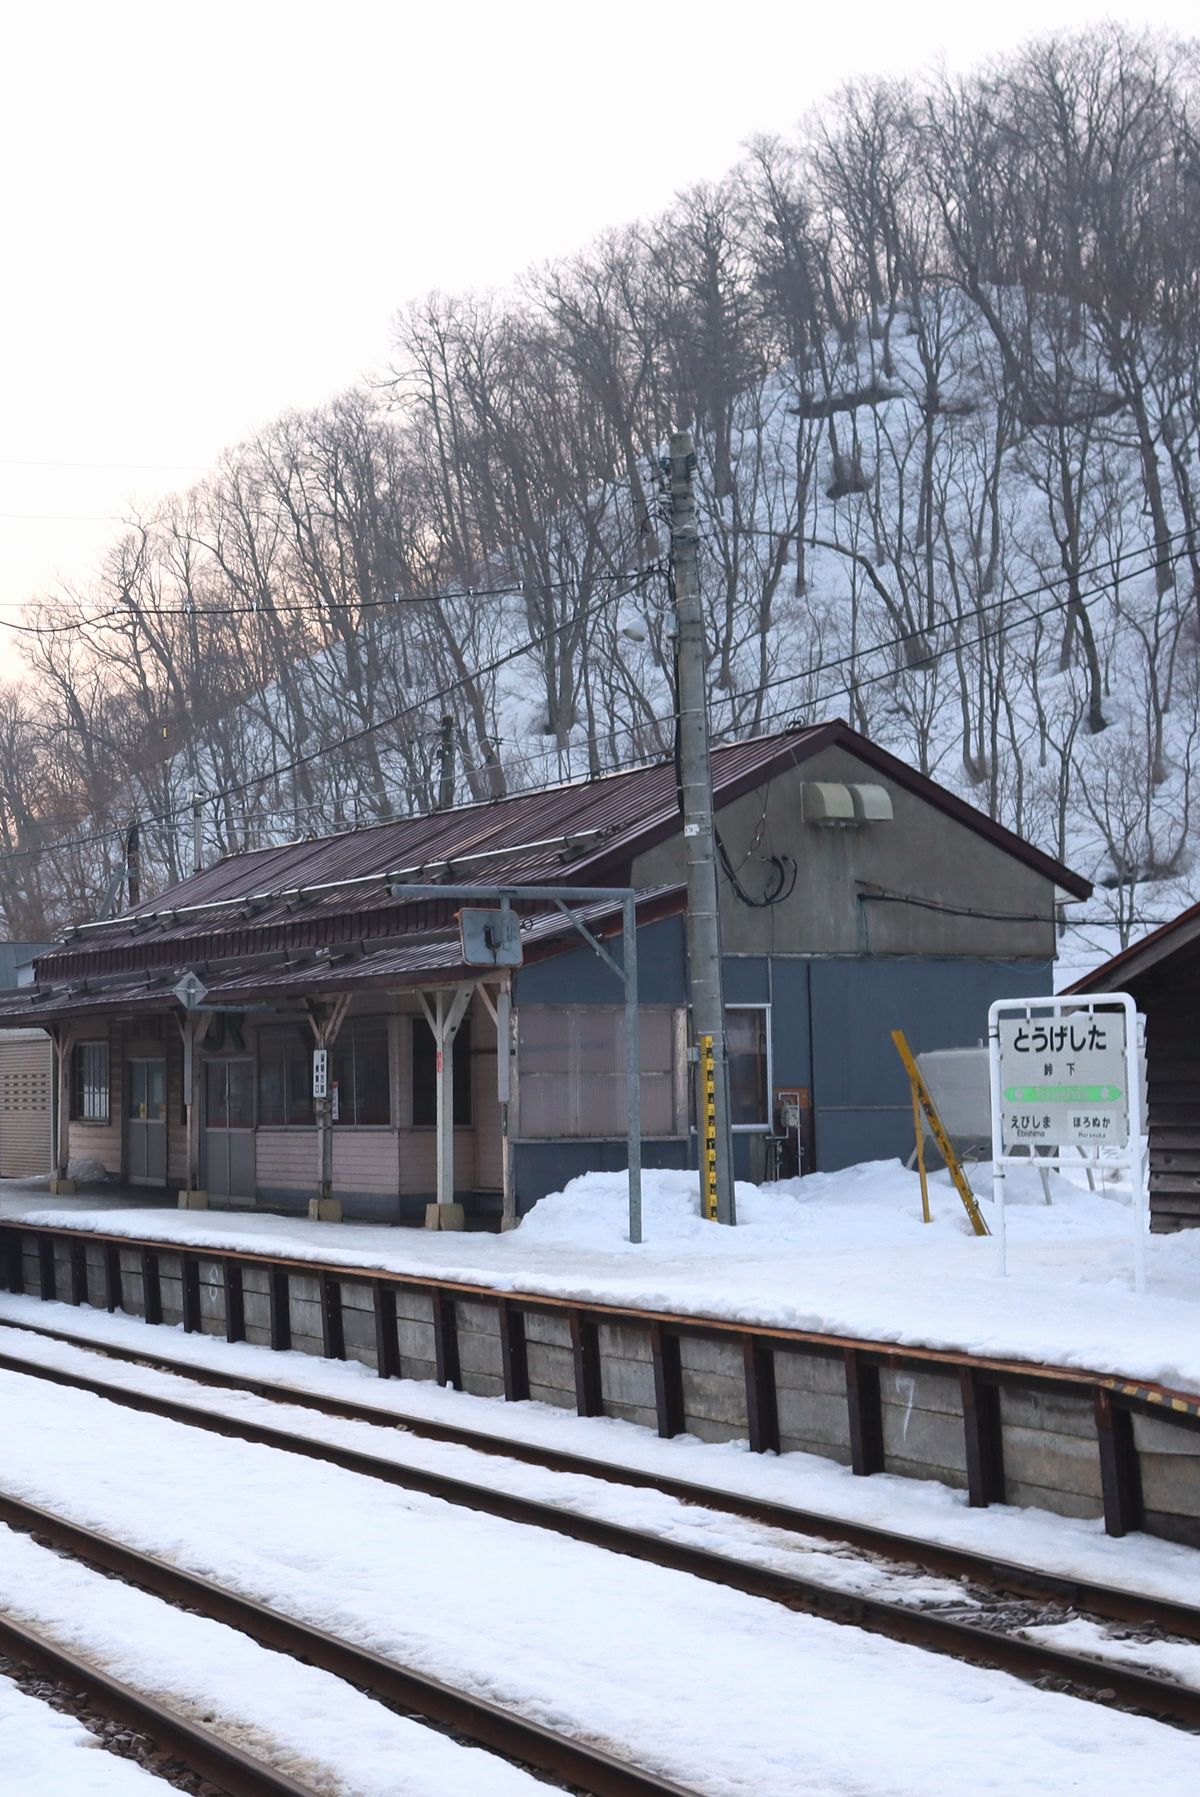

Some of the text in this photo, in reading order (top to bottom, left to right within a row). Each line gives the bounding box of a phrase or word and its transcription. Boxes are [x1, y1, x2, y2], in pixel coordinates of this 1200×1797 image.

[1013, 1024, 1107, 1053] とうげした
[1043, 1062, 1076, 1077] 峠下
[1010, 1115, 1051, 1129] えびしま
[1073, 1116, 1111, 1129] ほろぬか
[1016, 1129, 1046, 1138] Ebishima
